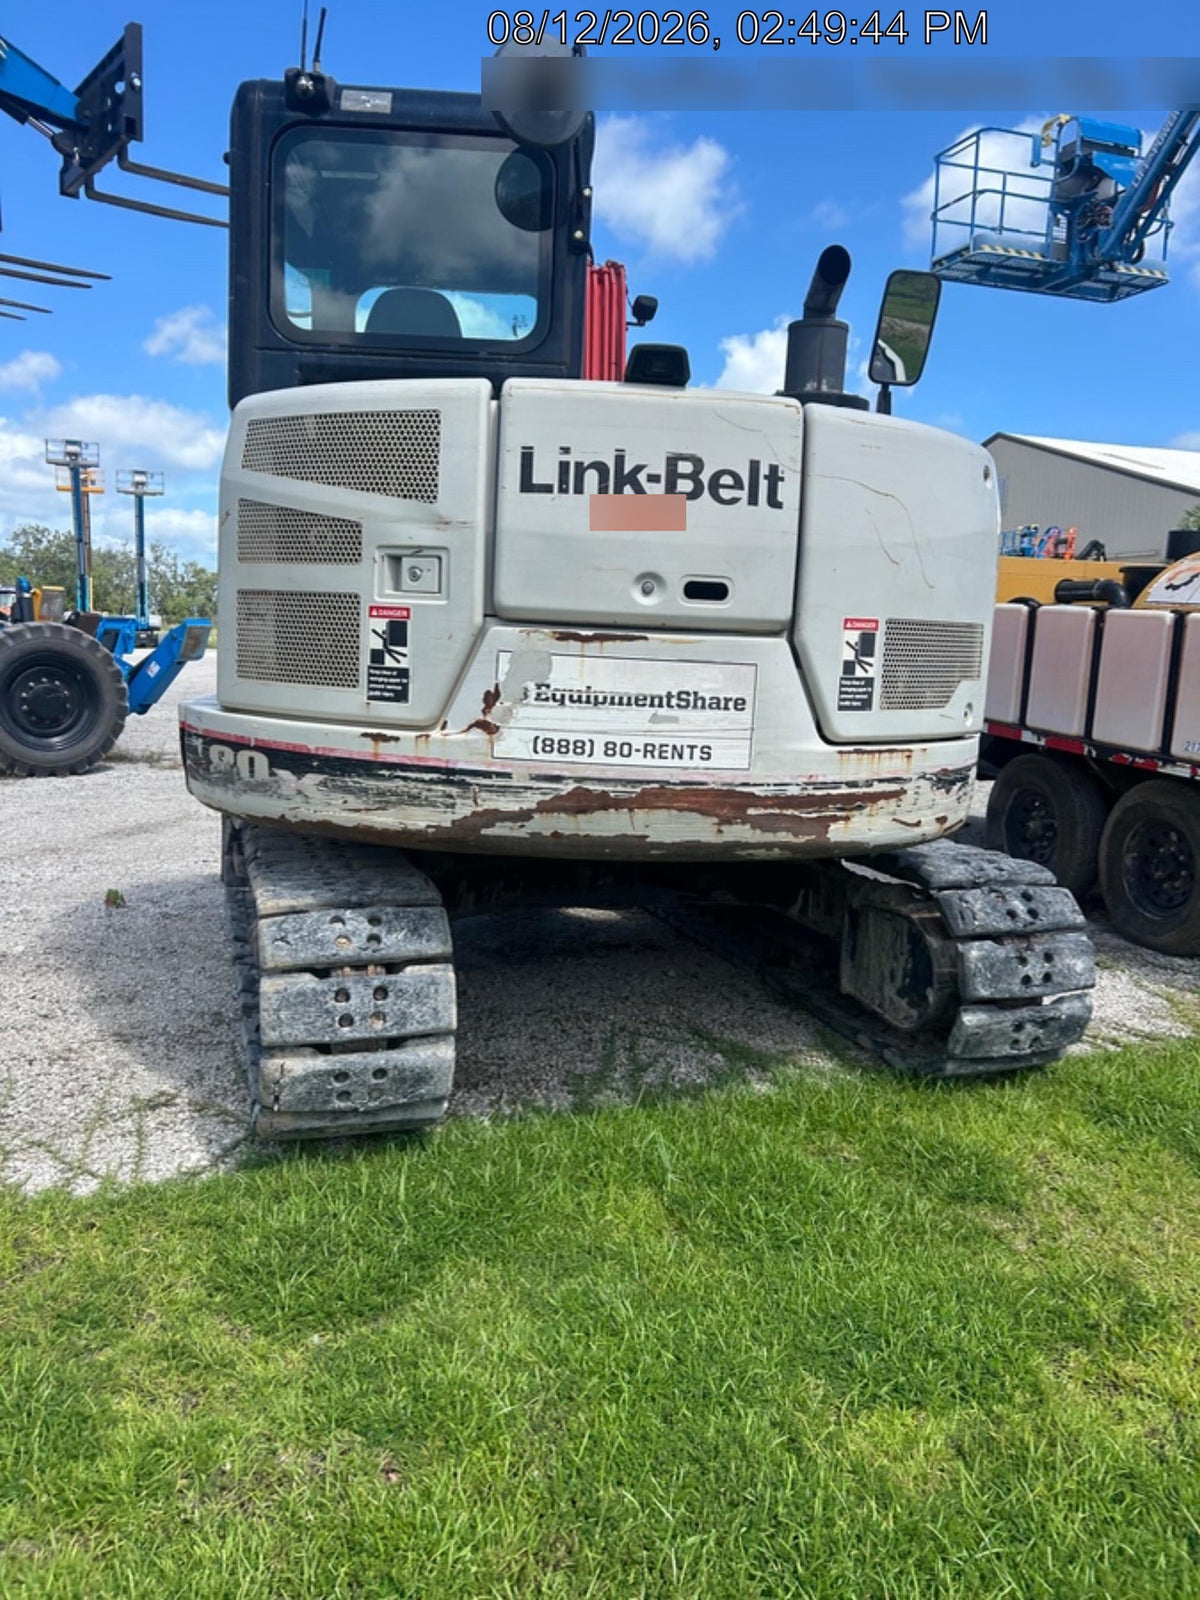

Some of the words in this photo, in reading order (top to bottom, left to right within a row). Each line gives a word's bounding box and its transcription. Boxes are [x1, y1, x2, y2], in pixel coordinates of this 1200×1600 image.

[519, 446, 785, 510] Link-Belt
[533, 683, 747, 712] EquipmentShare
[532, 735, 595, 758] (888)
[603, 741, 713, 761] 80-RENTS
